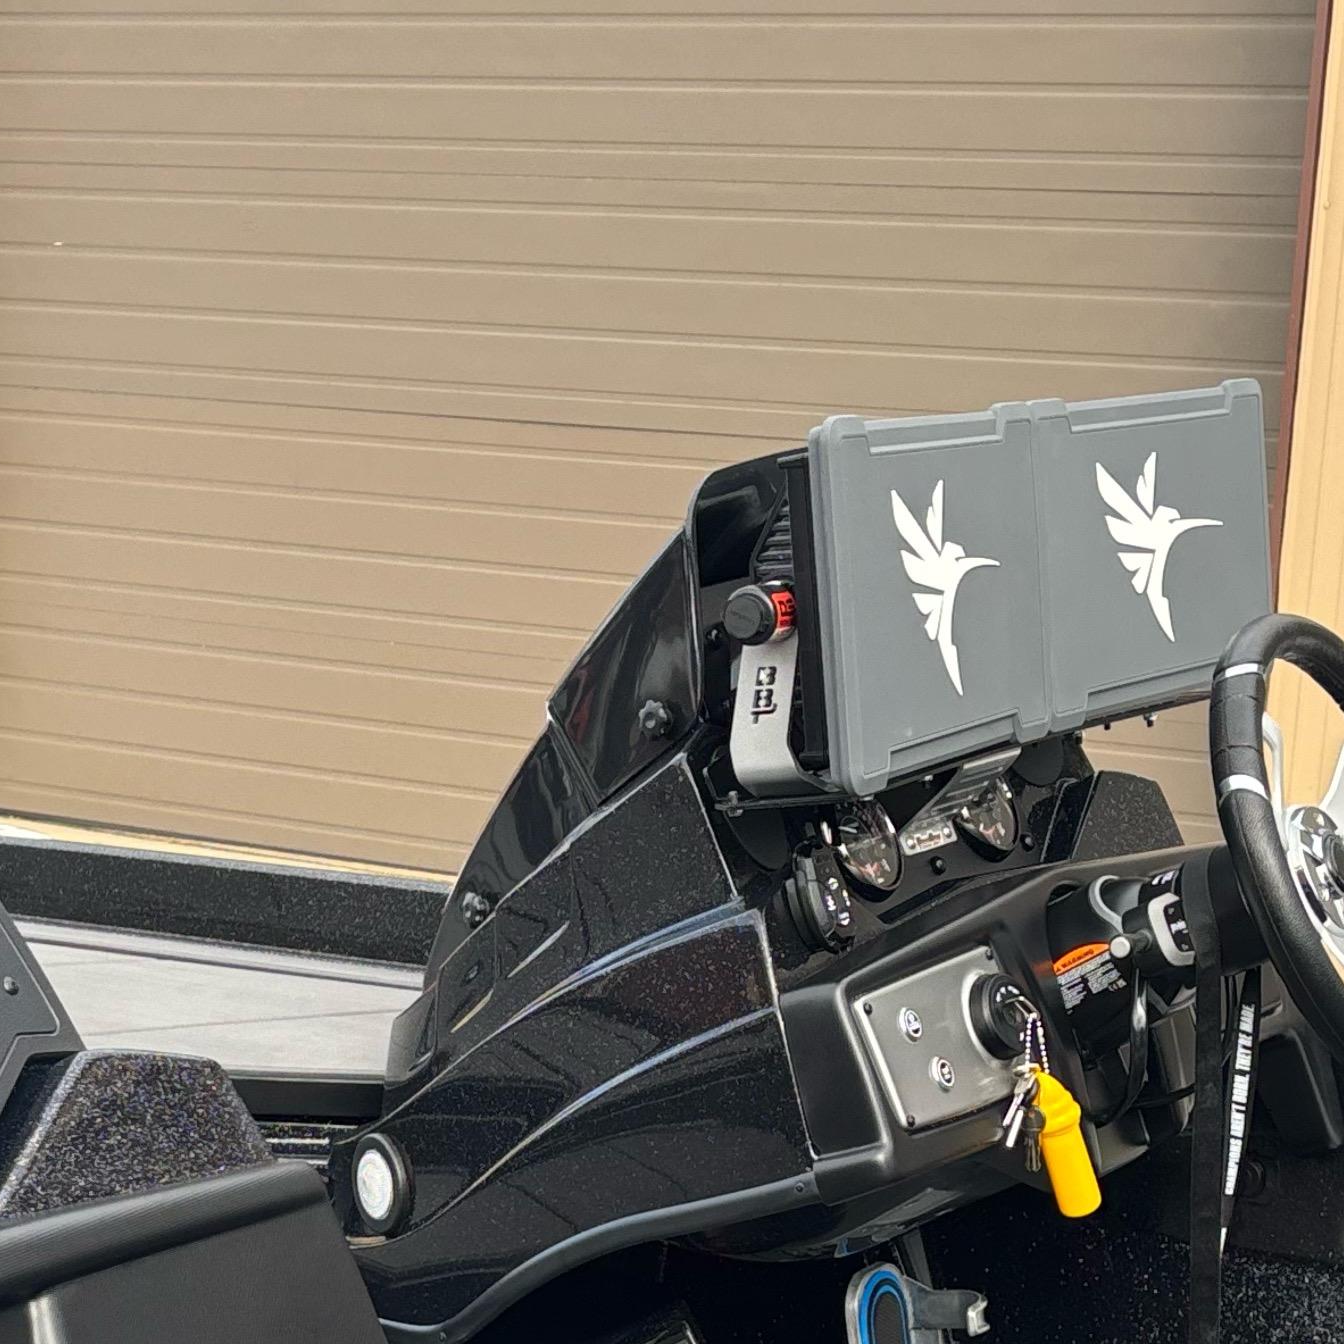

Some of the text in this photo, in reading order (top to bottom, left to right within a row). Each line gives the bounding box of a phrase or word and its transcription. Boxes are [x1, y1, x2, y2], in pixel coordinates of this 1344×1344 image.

[1234, 1032, 1253, 1071] THEY'RE
[1229, 1103, 1246, 1137] AREN'T
[1225, 1137, 1242, 1195] CHAMPIONS
